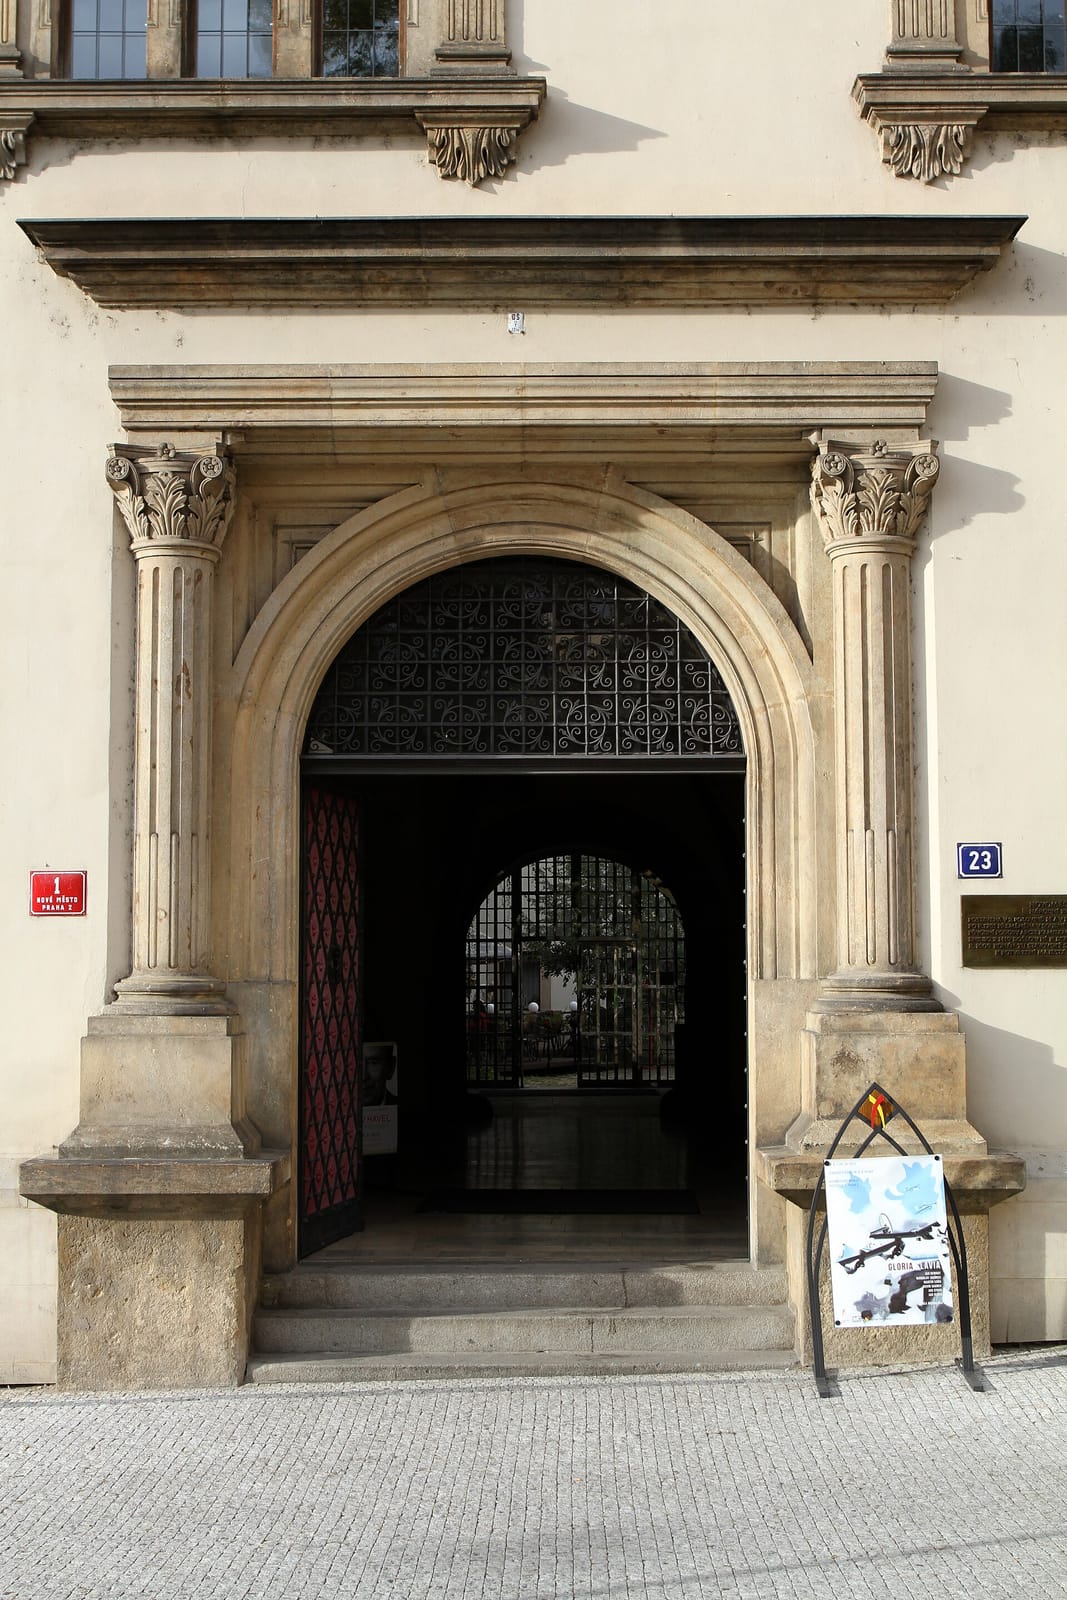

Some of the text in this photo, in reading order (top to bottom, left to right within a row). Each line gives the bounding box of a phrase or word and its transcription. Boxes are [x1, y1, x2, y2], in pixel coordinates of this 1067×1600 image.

[969, 851, 992, 870] 23
[54, 876, 60, 895] 1
[888, 1262, 914, 1271] GLORIA
